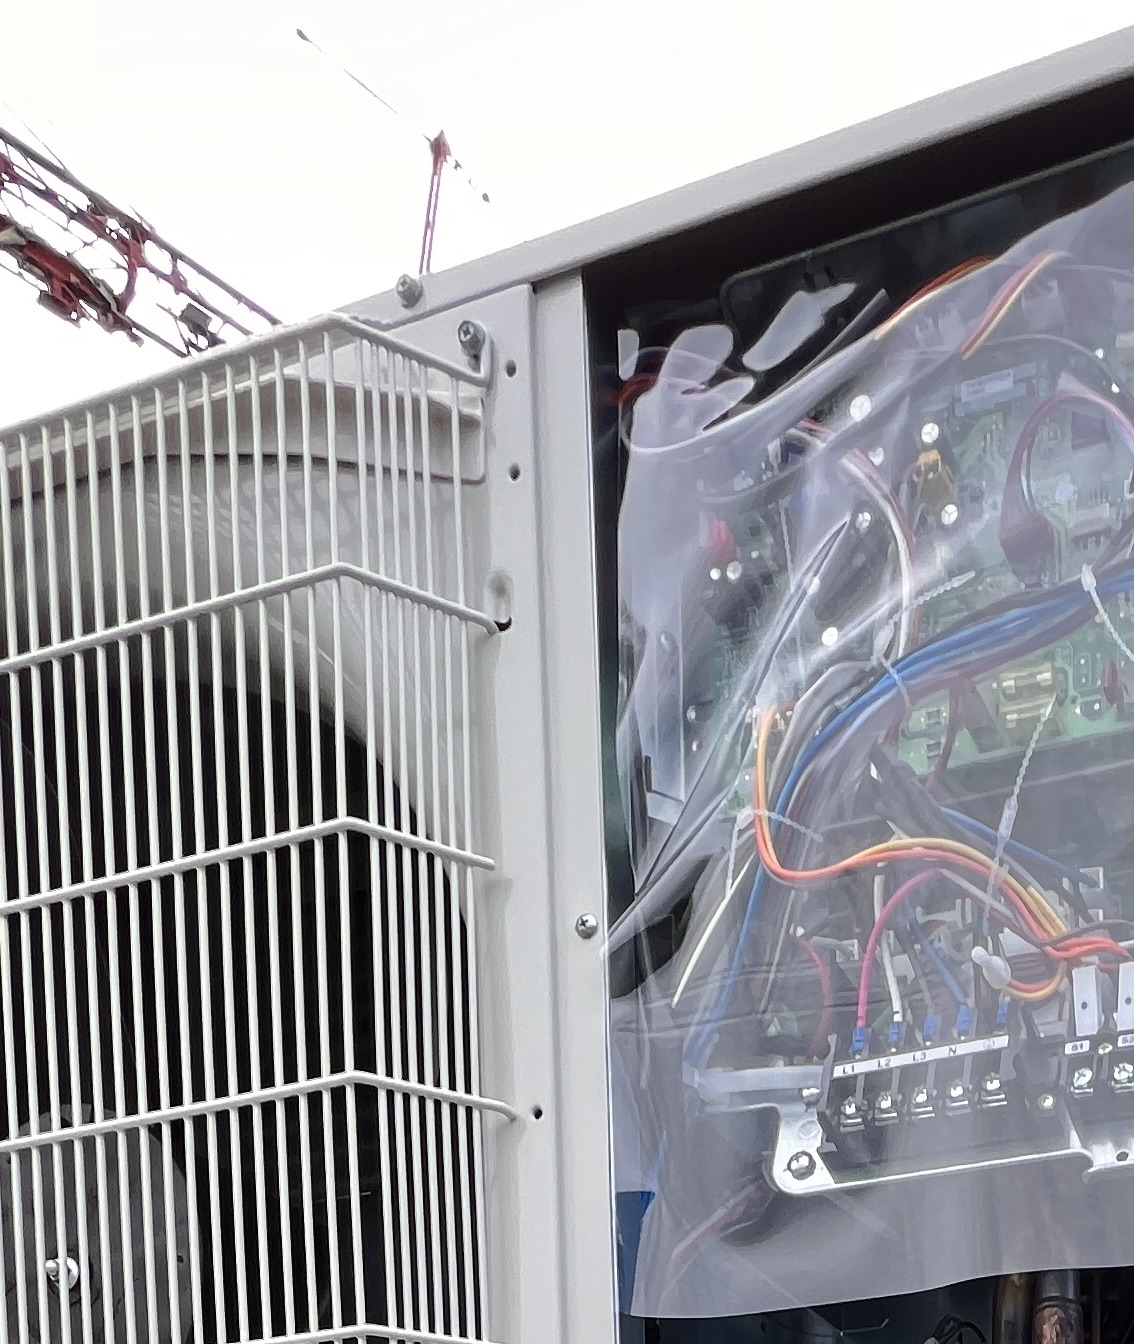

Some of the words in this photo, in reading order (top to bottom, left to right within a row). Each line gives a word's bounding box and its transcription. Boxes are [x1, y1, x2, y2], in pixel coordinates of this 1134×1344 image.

[842, 1065, 855, 1074] L1
[877, 1059, 891, 1067] L2
[913, 1052, 926, 1061] L3
[949, 1046, 957, 1055] N
